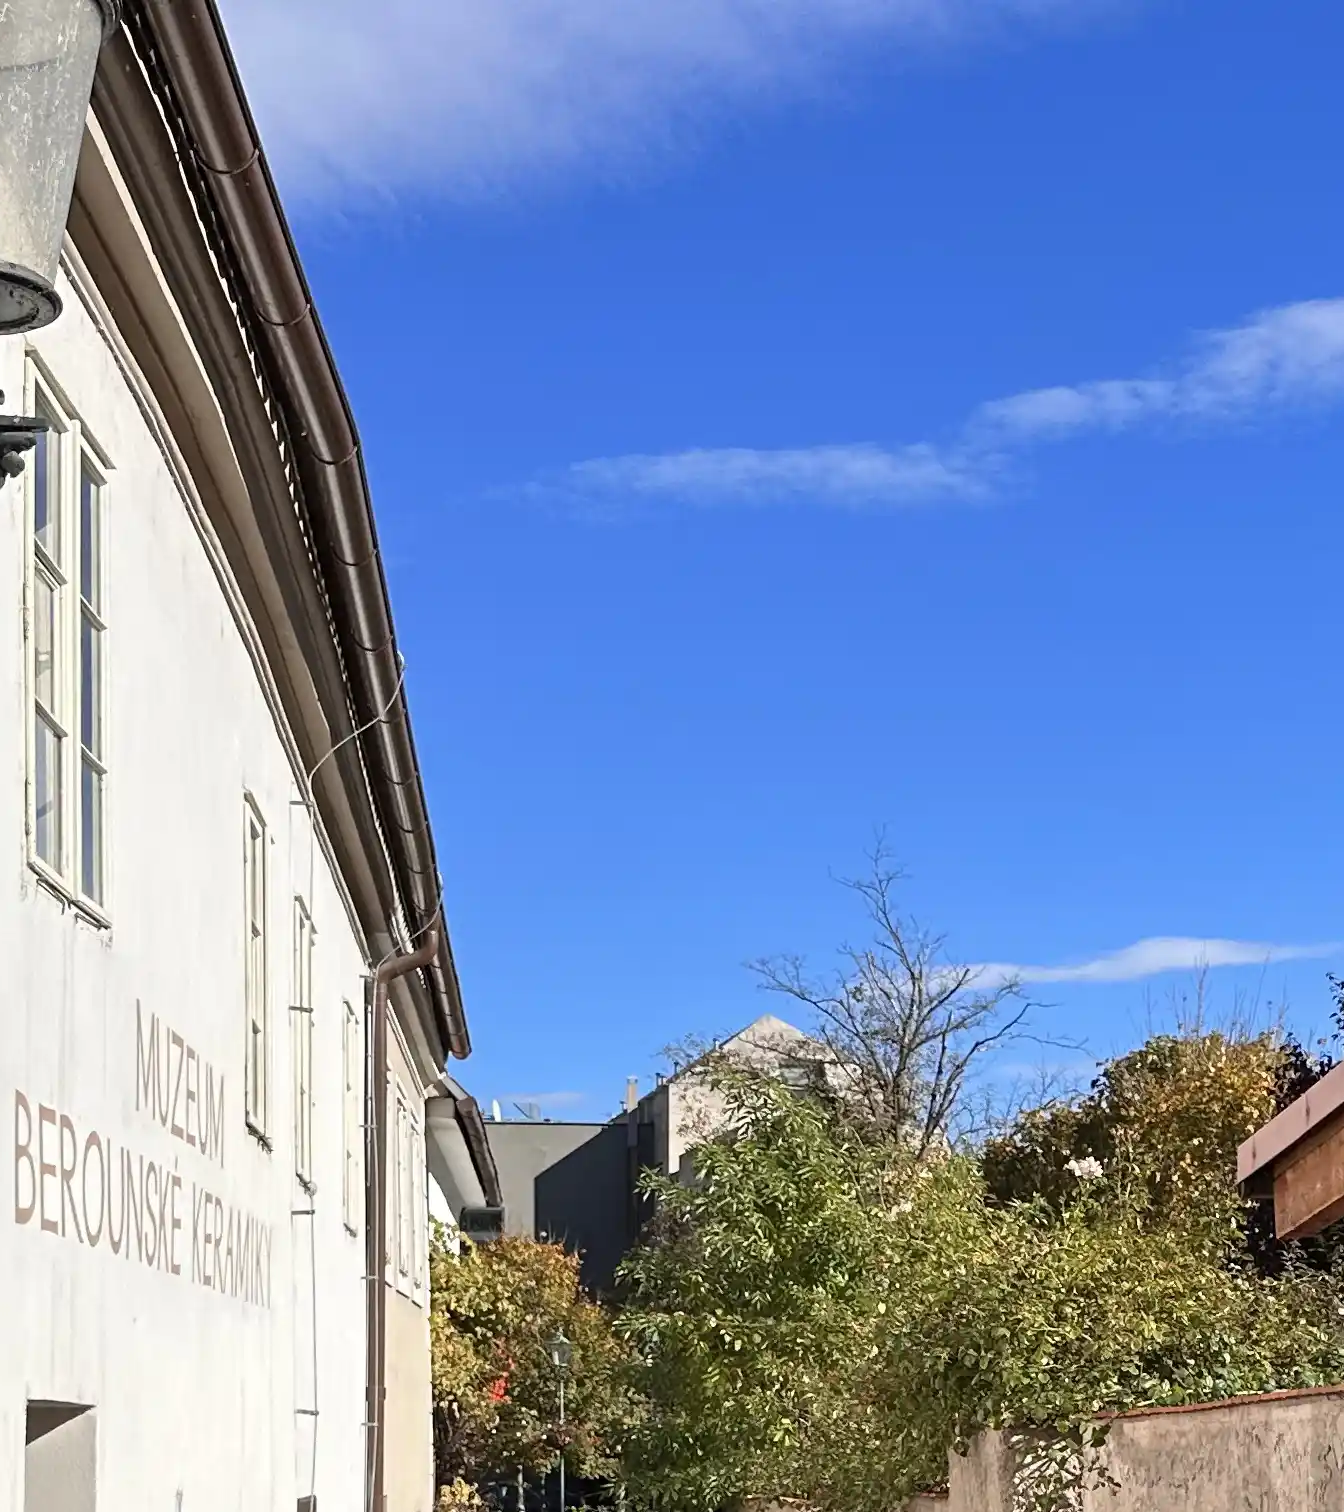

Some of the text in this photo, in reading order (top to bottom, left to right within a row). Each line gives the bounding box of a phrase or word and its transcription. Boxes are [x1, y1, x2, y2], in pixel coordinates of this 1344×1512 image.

[135, 997, 225, 1169] MUZEUM
[14, 1088, 273, 1310] BEROUNSKÉ KERAMIKY
